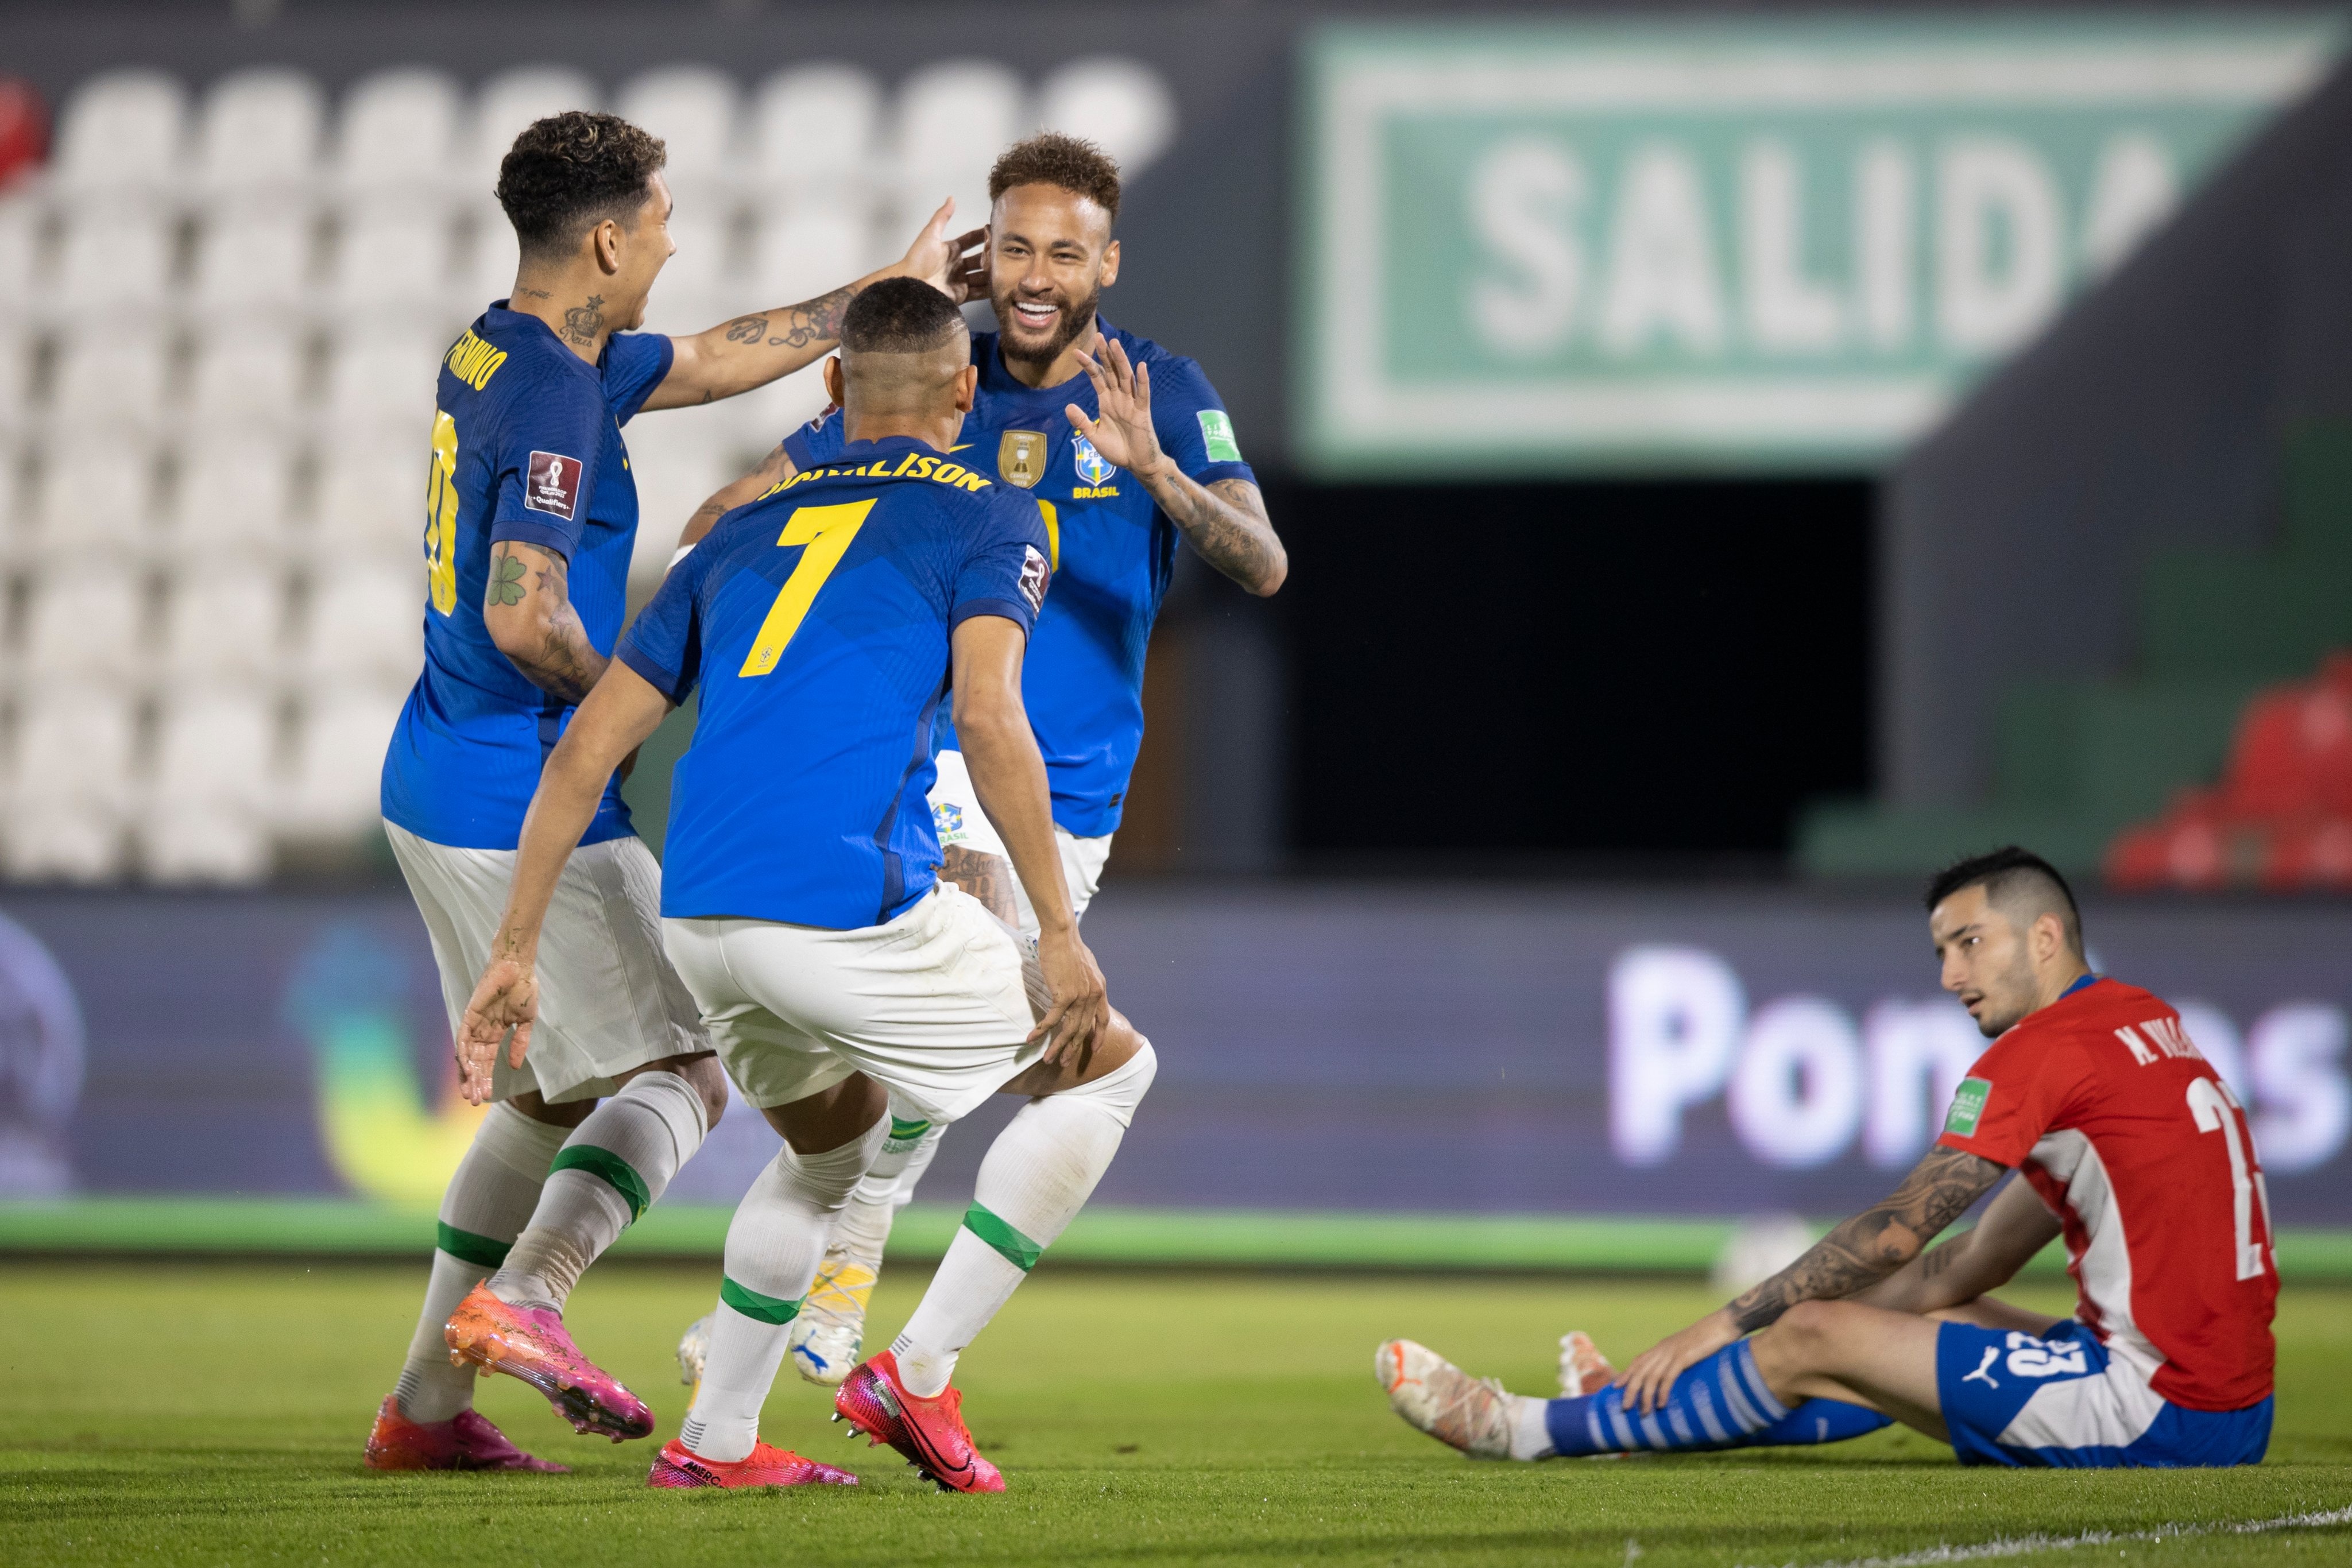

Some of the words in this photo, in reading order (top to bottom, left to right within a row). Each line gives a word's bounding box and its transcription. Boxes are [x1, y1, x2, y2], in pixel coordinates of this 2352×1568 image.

[1073, 487, 1119, 499] BRASIL
[536, 496, 567, 509] Qualifiers
[738, 498, 878, 677] 7
[939, 833, 969, 843] RASIL
[2185, 1076, 2278, 1281] 2
